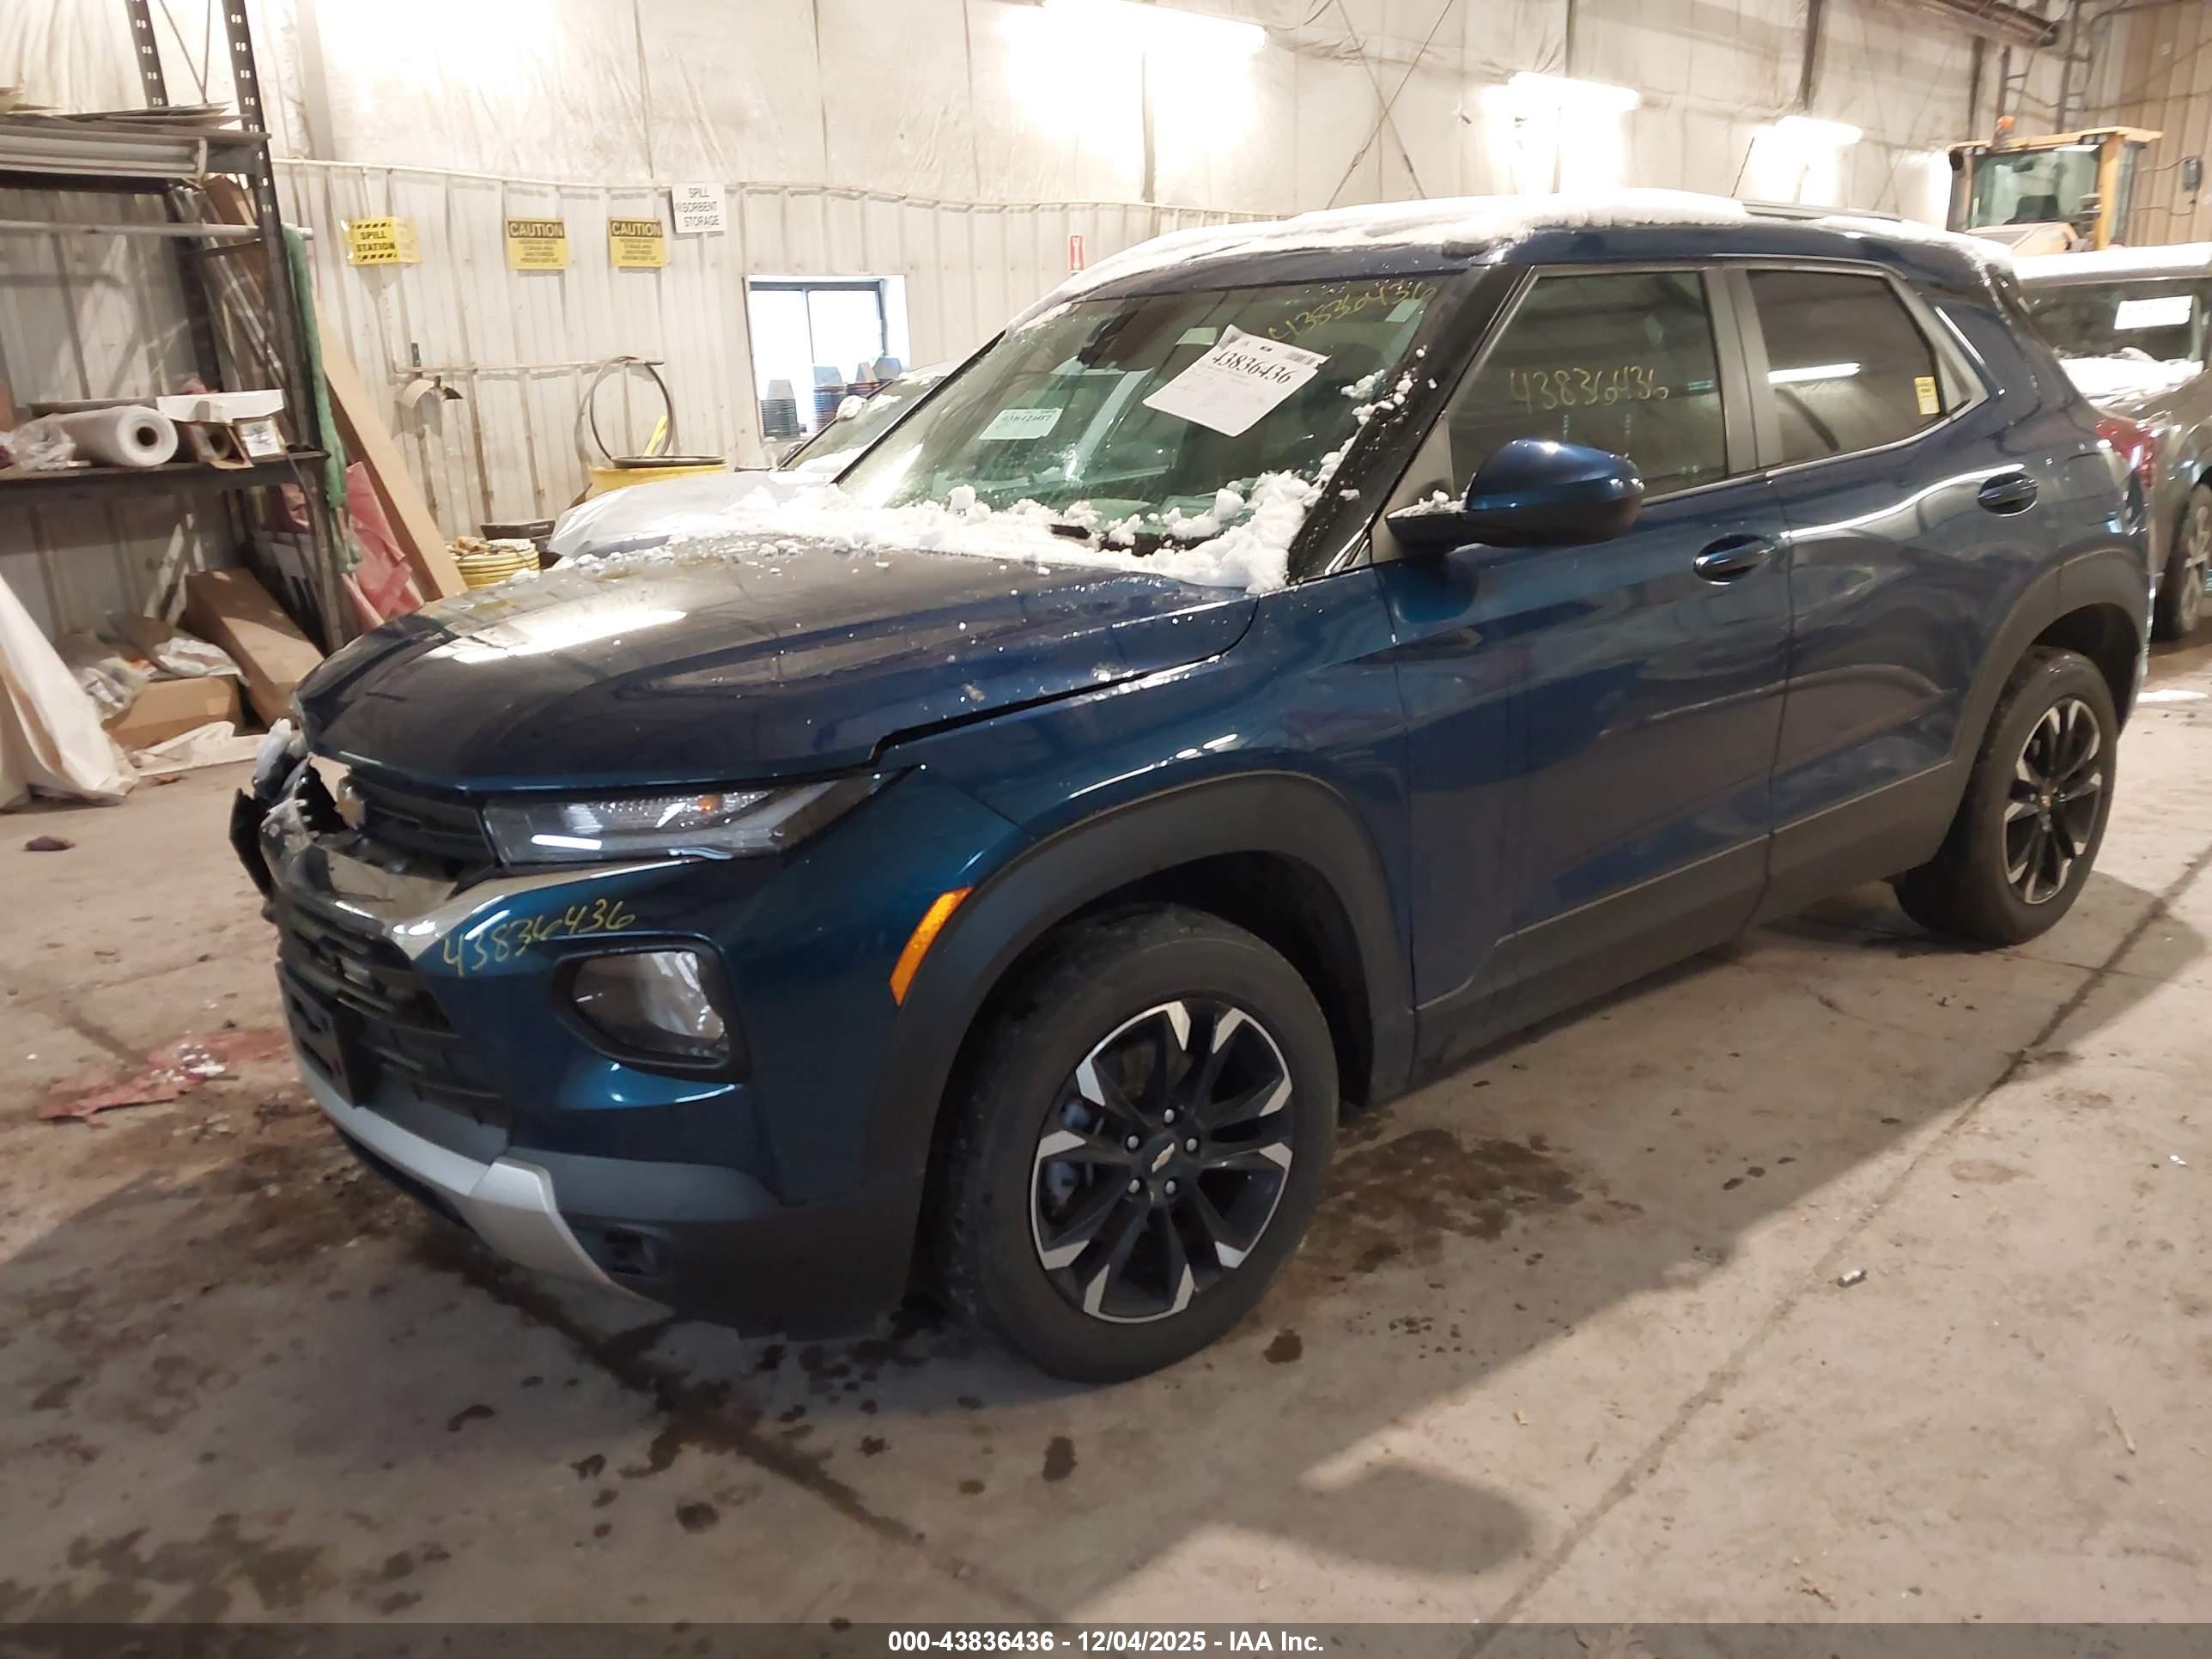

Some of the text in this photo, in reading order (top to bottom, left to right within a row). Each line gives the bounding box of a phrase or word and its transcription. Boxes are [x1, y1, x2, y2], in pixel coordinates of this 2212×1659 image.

[688, 186, 710, 198] SPILL
[675, 200, 717, 213] SORBENT
[684, 215, 720, 228] STORAGE
[360, 230, 386, 240] SPILL
[510, 222, 563, 237] CAUTION
[611, 222, 660, 236] CAUTION
[356, 242, 395, 252] STATION
[1212, 349, 1297, 385] 43836436
[443, 899, 636, 977] 43836436
